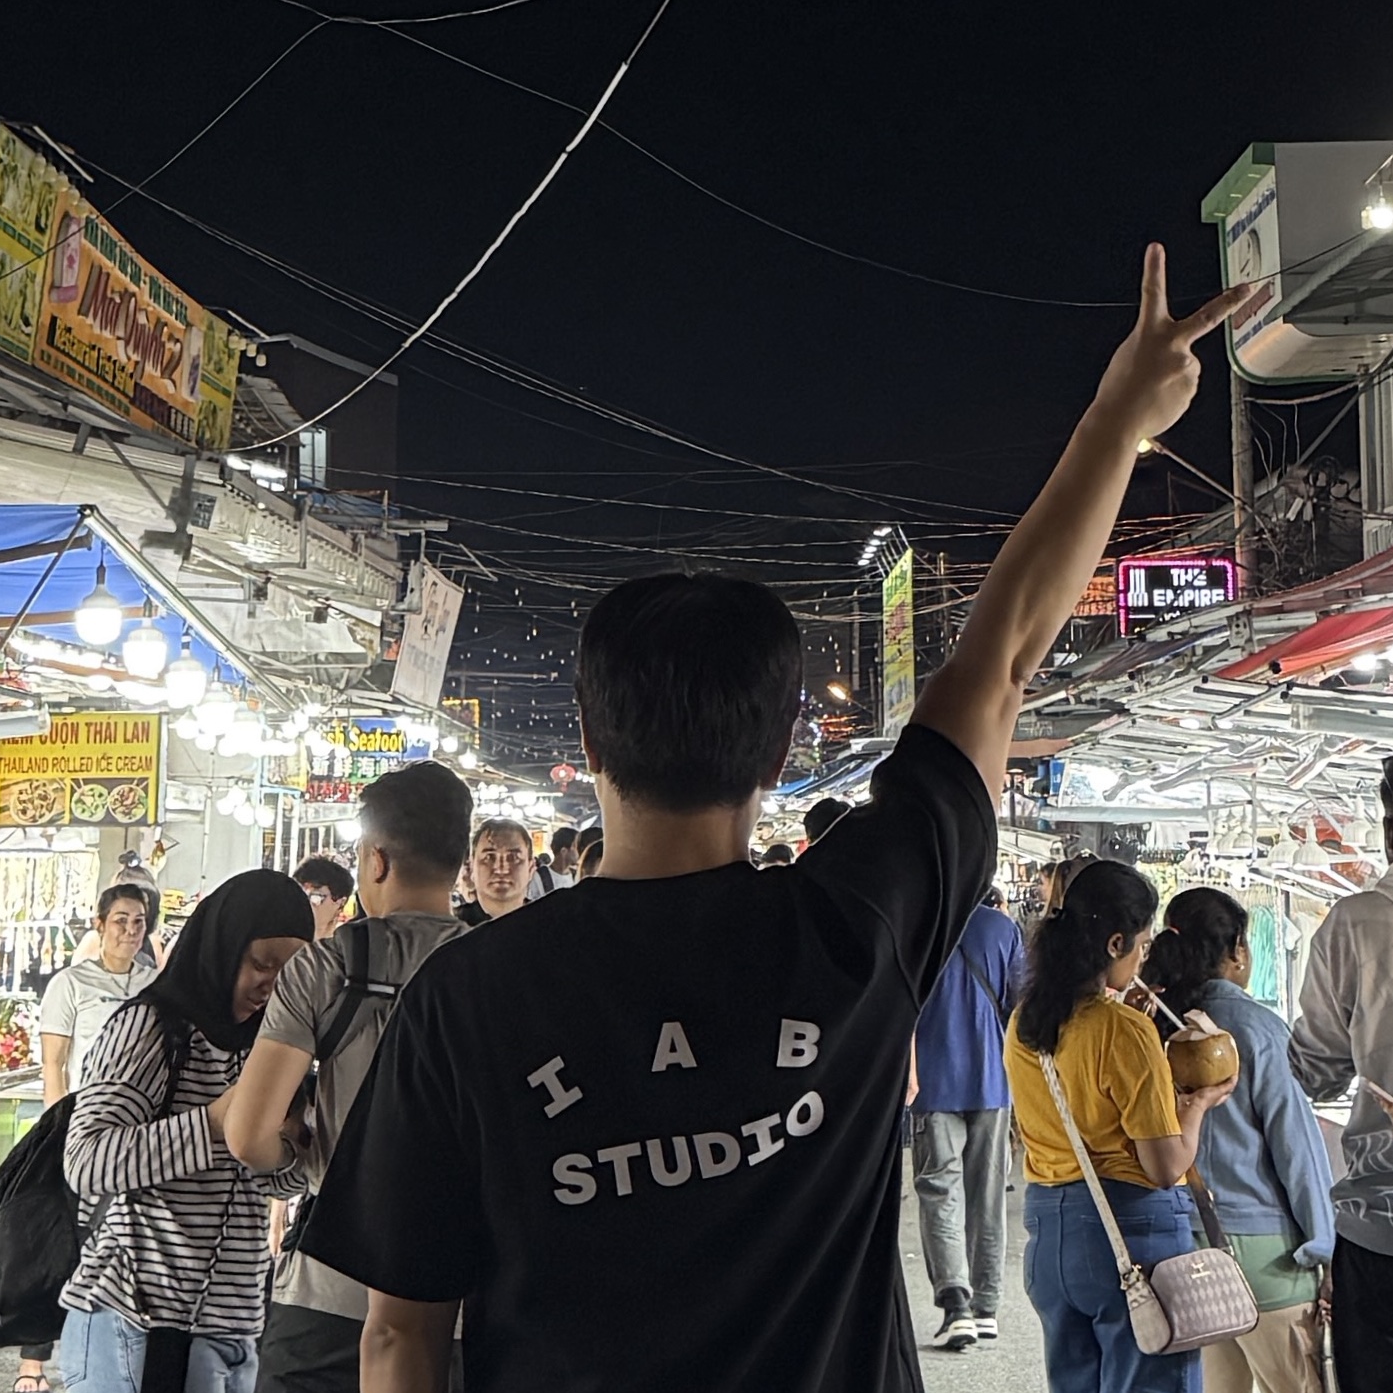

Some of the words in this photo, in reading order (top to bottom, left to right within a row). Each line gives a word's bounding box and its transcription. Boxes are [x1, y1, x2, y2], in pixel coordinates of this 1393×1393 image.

[1170, 567, 1207, 587] THE
[1152, 588, 1225, 607] EMPIRE
[84, 715, 119, 745] THÁI
[123, 720, 151, 744] LAN
[52, 755, 94, 775] ROLLED
[114, 754, 154, 772] CREAM
[650, 1020, 698, 1073] A
[776, 1018, 822, 1068] B
[551, 1090, 825, 1206] STUDIO
